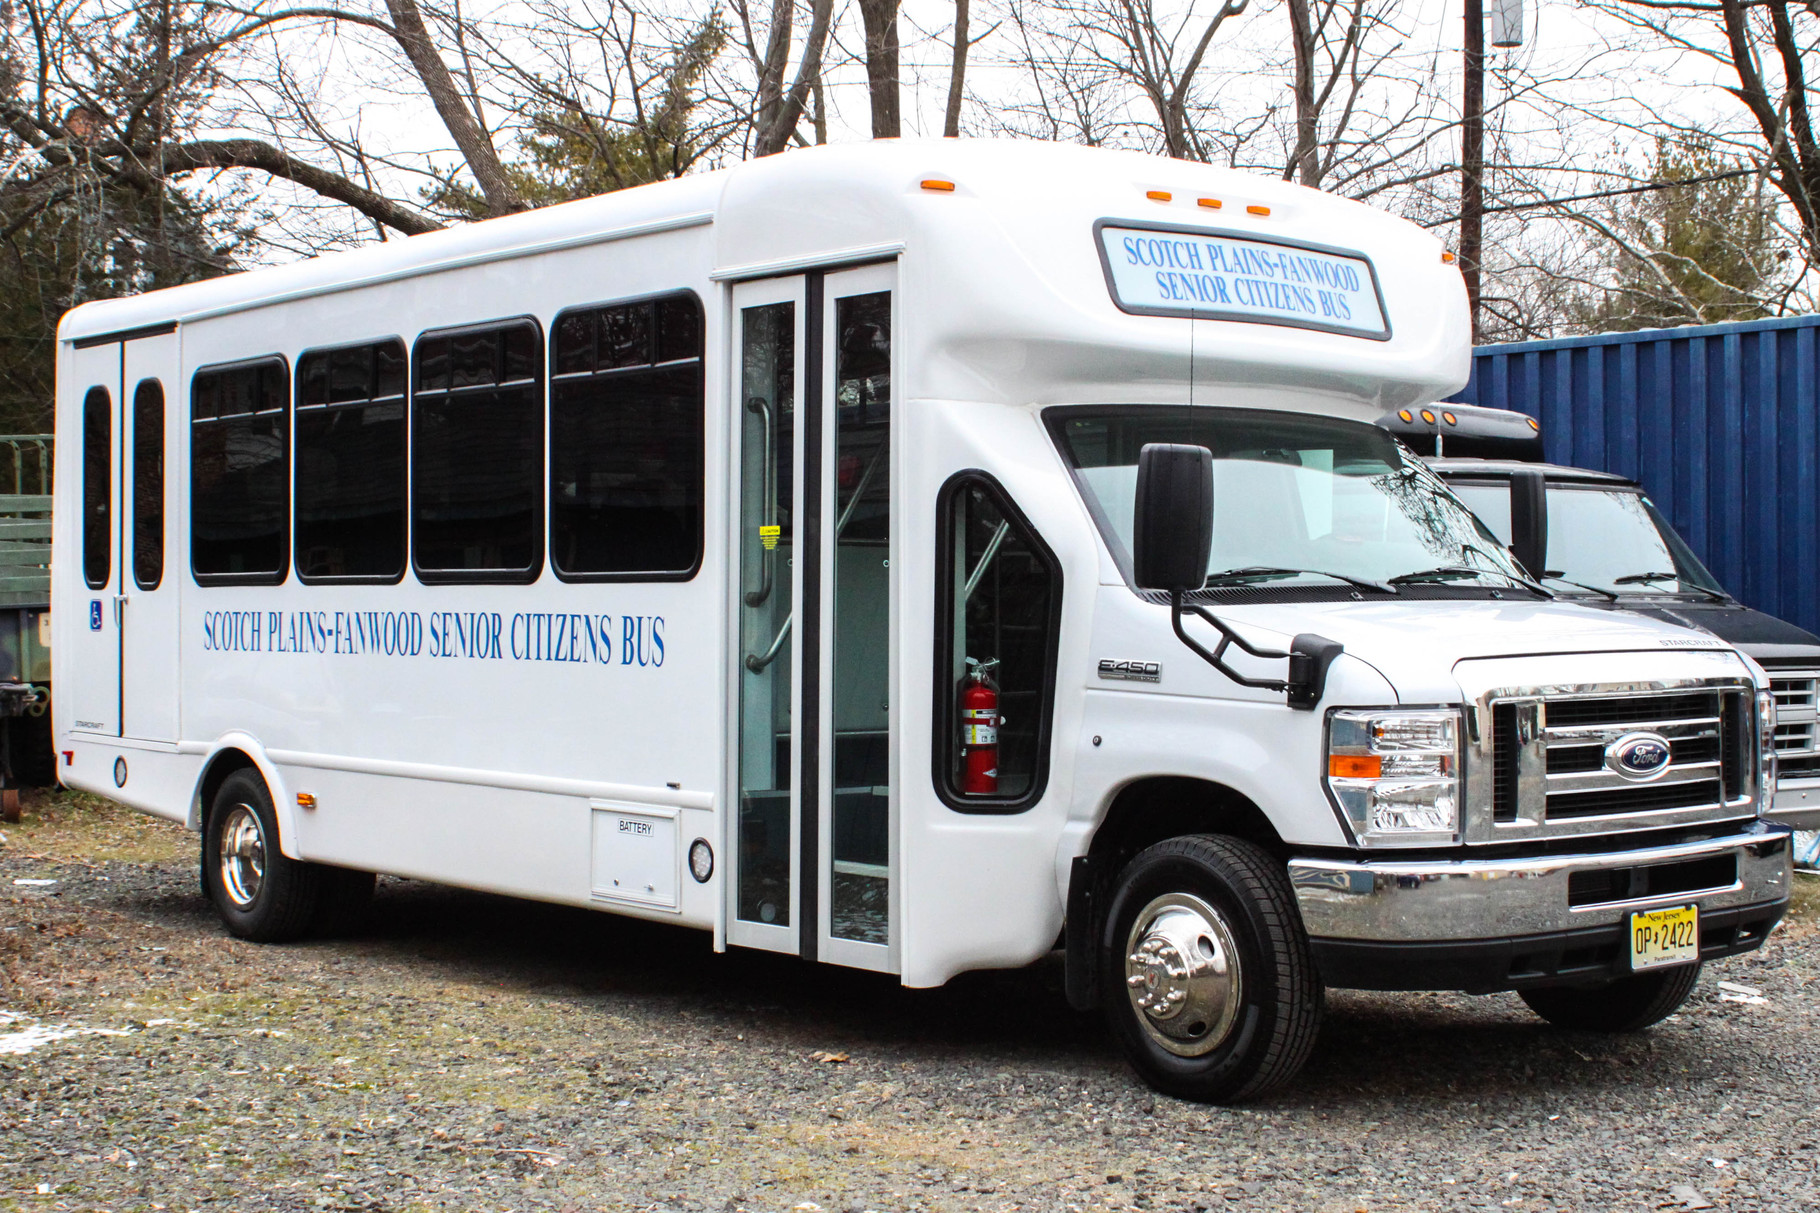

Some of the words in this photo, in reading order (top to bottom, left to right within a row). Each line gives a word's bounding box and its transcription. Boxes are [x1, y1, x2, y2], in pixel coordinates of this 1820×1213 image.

[1123, 237, 1205, 270] SCOTCH
[1206, 243, 1360, 292] PLAINS-FANWOOD
[1156, 271, 1232, 304] SENIOR
[1234, 277, 1317, 316] CITIZENS
[1318, 290, 1352, 320] BUS
[204, 611, 262, 651] SCOTCH
[268, 611, 423, 656] PLAINS-FANWOOD
[429, 611, 503, 659] SENIOR
[511, 612, 612, 664] CITIZENS
[621, 615, 665, 667] BUS
[1633, 745, 1660, 765] Ford
[619, 820, 652, 835] BATTERY
[1648, 914, 1662, 922] New
[1663, 911, 1680, 922] Jersey
[1636, 926, 1652, 954] OP
[1661, 920, 1694, 951] 2422
